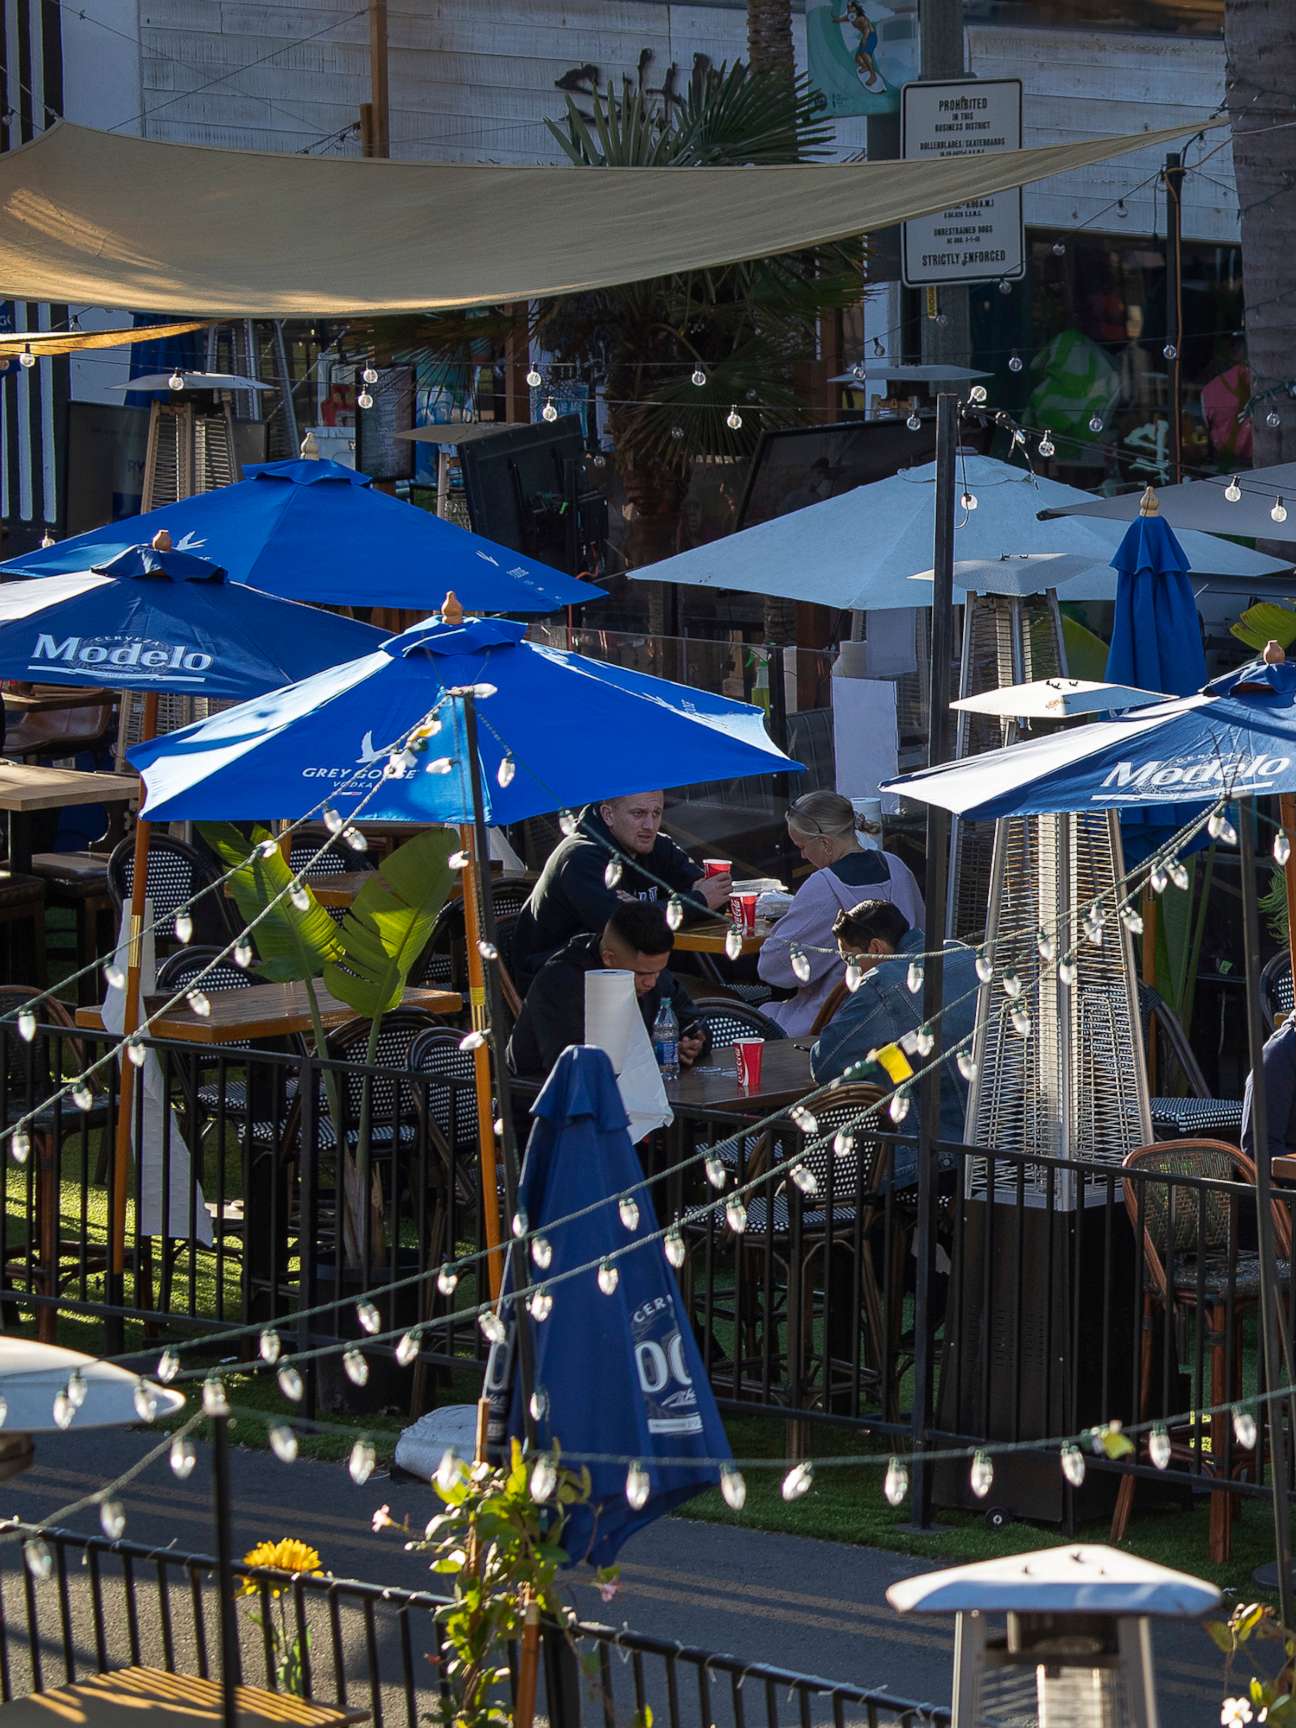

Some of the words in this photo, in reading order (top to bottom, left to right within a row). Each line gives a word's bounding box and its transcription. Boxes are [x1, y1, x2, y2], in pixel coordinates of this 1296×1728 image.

[939, 97, 988, 112] PROHIBITED
[935, 123, 963, 132] BUSINESS
[965, 121, 991, 130] DISTRICT
[922, 253, 960, 266] STRICTLY
[963, 250, 1006, 264] ENFORCED
[31, 633, 212, 671] Modelo
[302, 767, 352, 778] GREY
[1101, 753, 1291, 788] Modelo
[333, 781, 373, 789] VODKA
